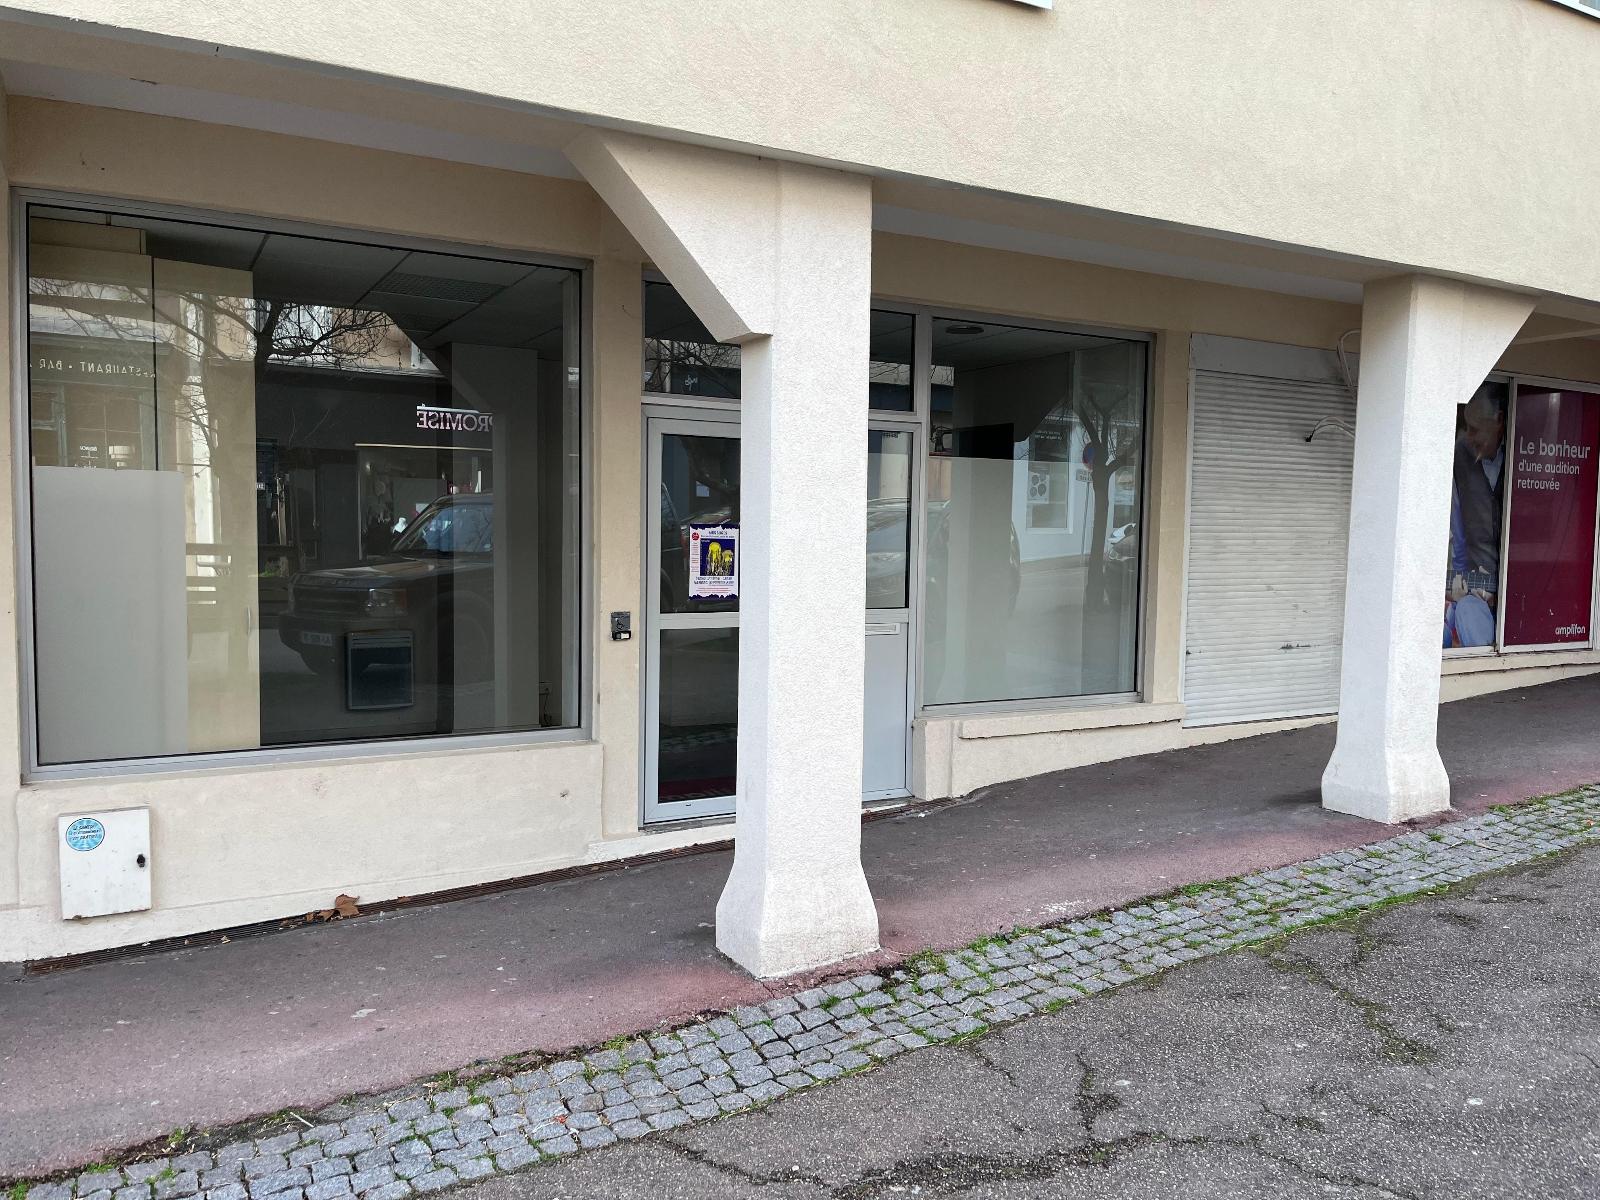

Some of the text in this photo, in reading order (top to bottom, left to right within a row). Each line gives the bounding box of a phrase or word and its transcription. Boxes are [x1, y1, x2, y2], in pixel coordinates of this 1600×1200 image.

[1520, 436, 1590, 459] Le bonheur
[1518, 459, 1580, 475] d'une audition
[1517, 478, 1560, 491] retrouvée
[1555, 624, 1586, 637] amplifon
